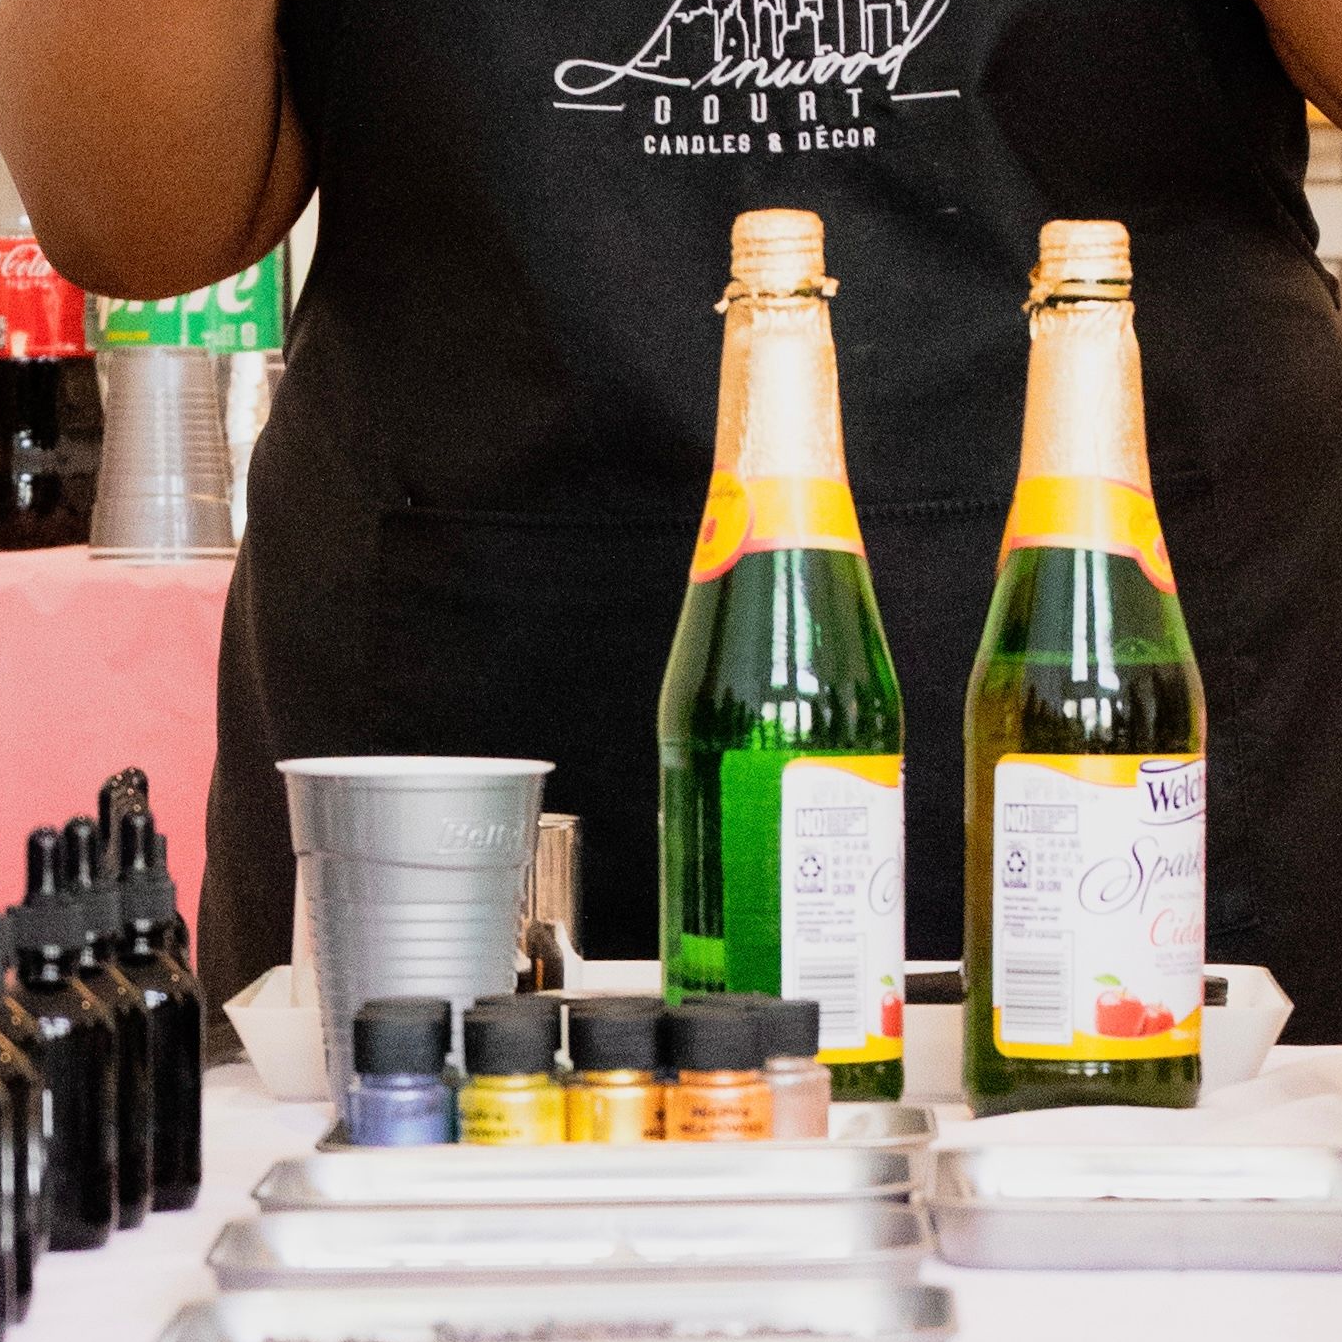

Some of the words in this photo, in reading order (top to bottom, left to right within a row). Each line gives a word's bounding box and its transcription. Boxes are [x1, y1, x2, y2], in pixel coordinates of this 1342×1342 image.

[654, 88, 863, 125] COURT
[643, 134, 751, 155] CANDLES
[767, 132, 783, 153] &
[798, 124, 876, 151] DÉCOR
